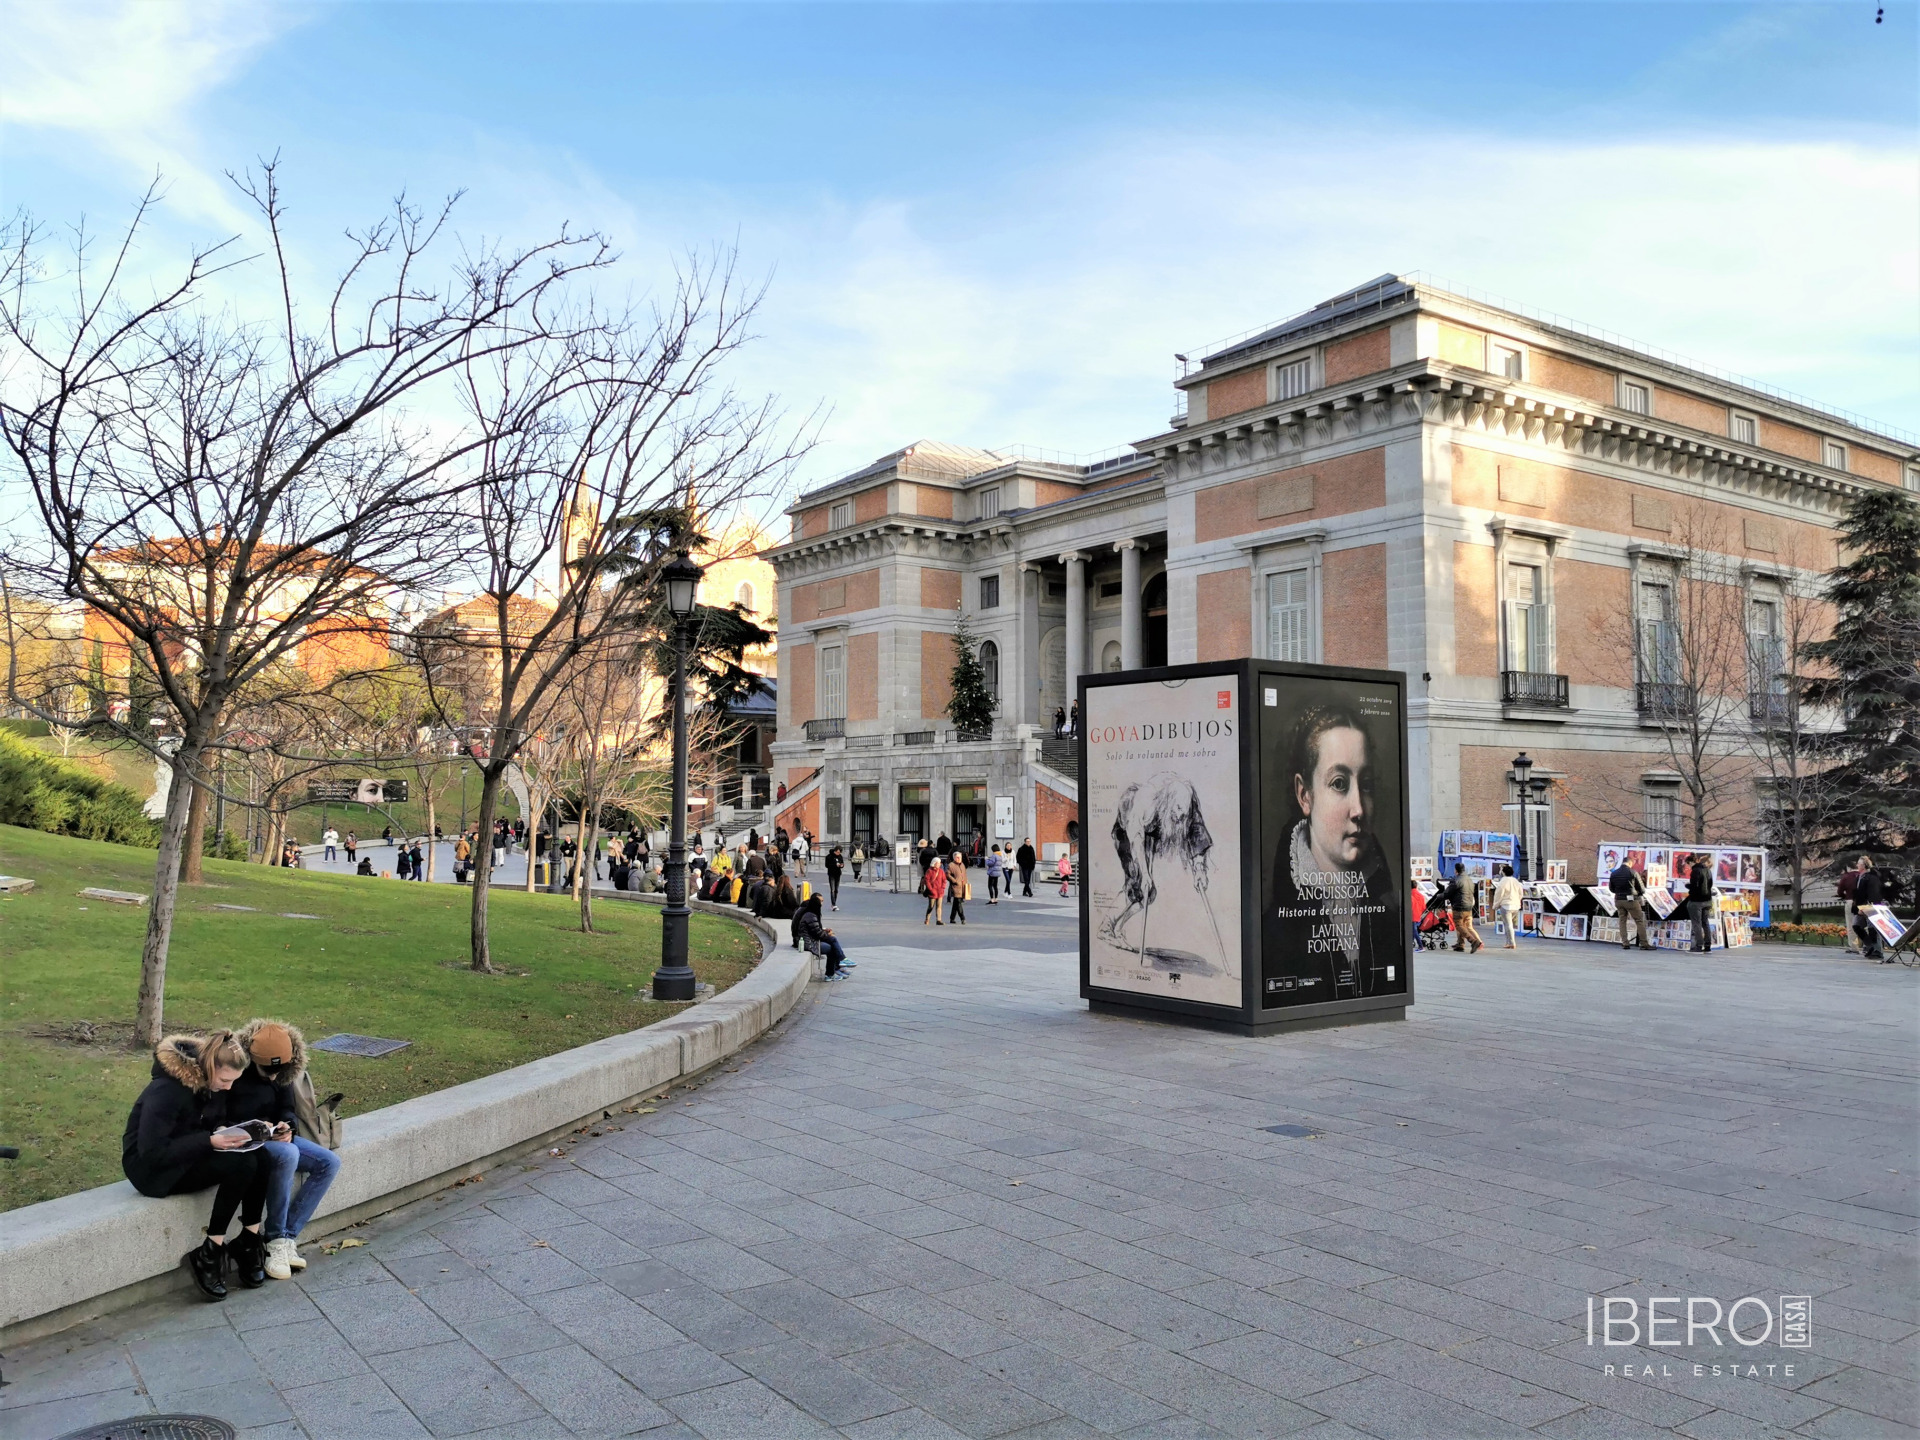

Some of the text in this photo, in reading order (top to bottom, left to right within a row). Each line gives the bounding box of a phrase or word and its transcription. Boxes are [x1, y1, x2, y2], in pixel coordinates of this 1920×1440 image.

[1106, 752, 1122, 761] Solo
[1126, 750, 1134, 760] la
[1138, 749, 1174, 760] voluntad
[1193, 748, 1216, 758] sobra
[1302, 871, 1365, 886] SOFONISBA
[1297, 885, 1369, 900] ANGUISSOLA
[1278, 904, 1386, 918] Historia de dos pintoras
[1312, 923, 1355, 938] LAVINIA
[1308, 937, 1360, 954] FONTANA
